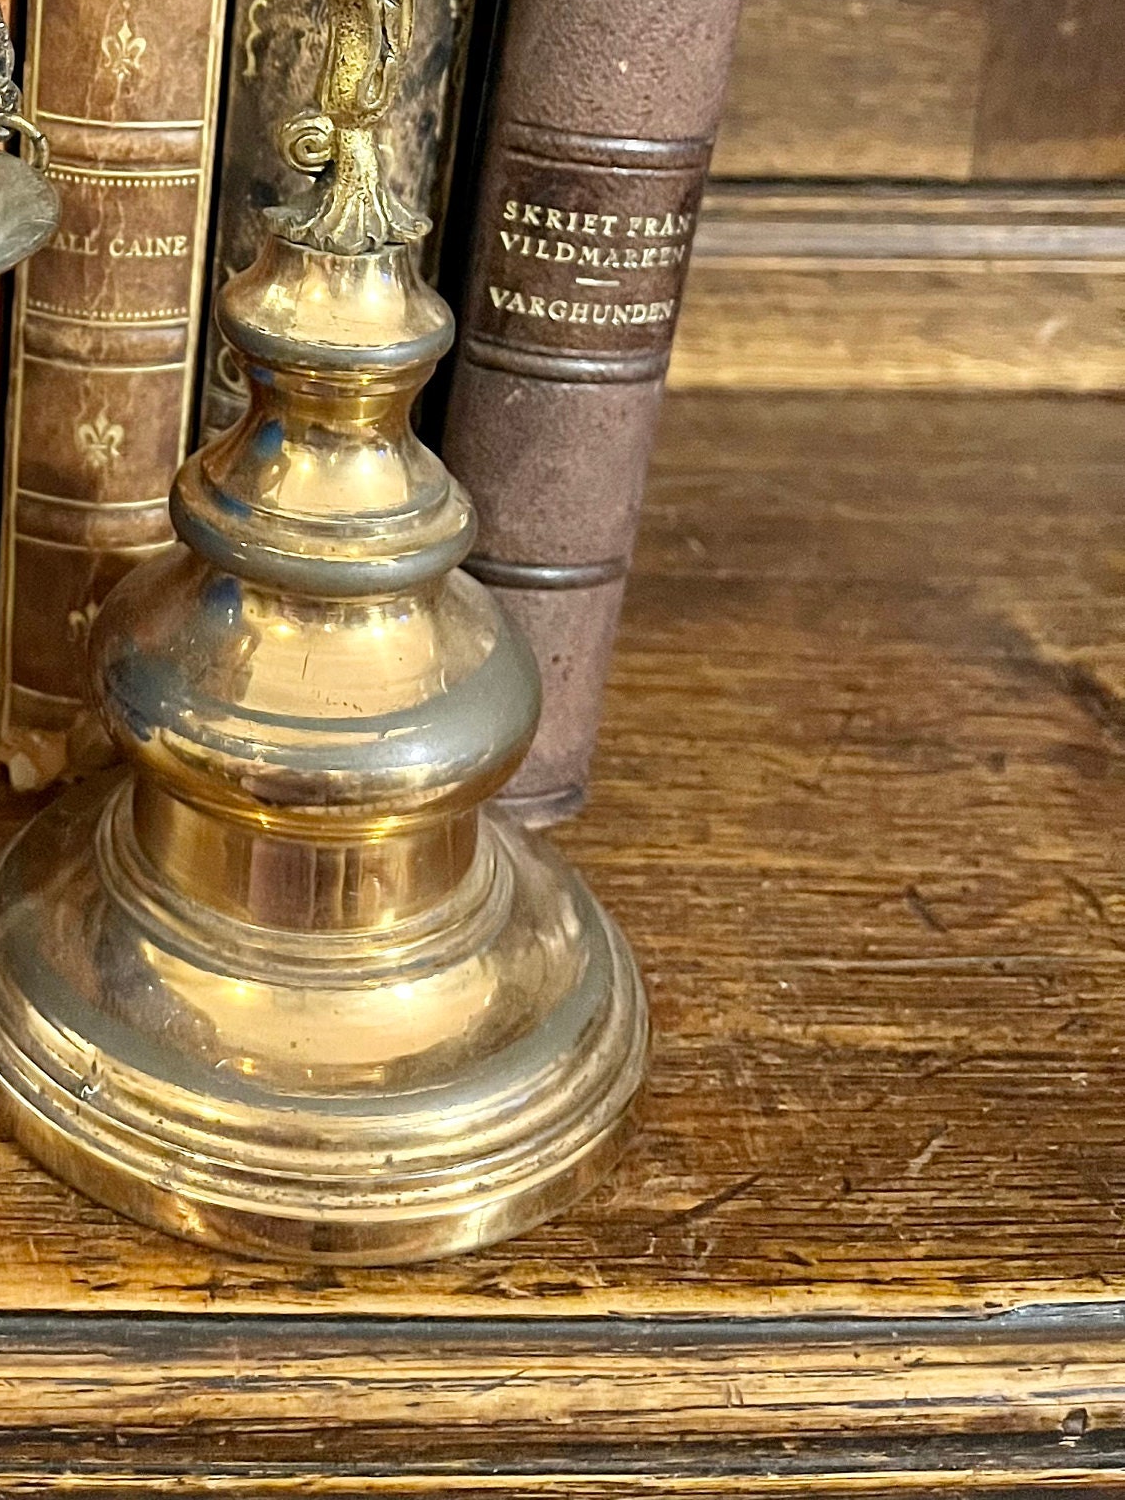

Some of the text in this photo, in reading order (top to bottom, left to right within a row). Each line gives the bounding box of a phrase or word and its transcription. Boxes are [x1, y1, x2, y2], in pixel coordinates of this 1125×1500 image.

[503, 200, 693, 238] SKRIET FRÅN
[53, 231, 189, 257] ALL CAINE
[499, 231, 687, 269] VILDMARKEN
[489, 286, 674, 326] VARGHUNDEN
